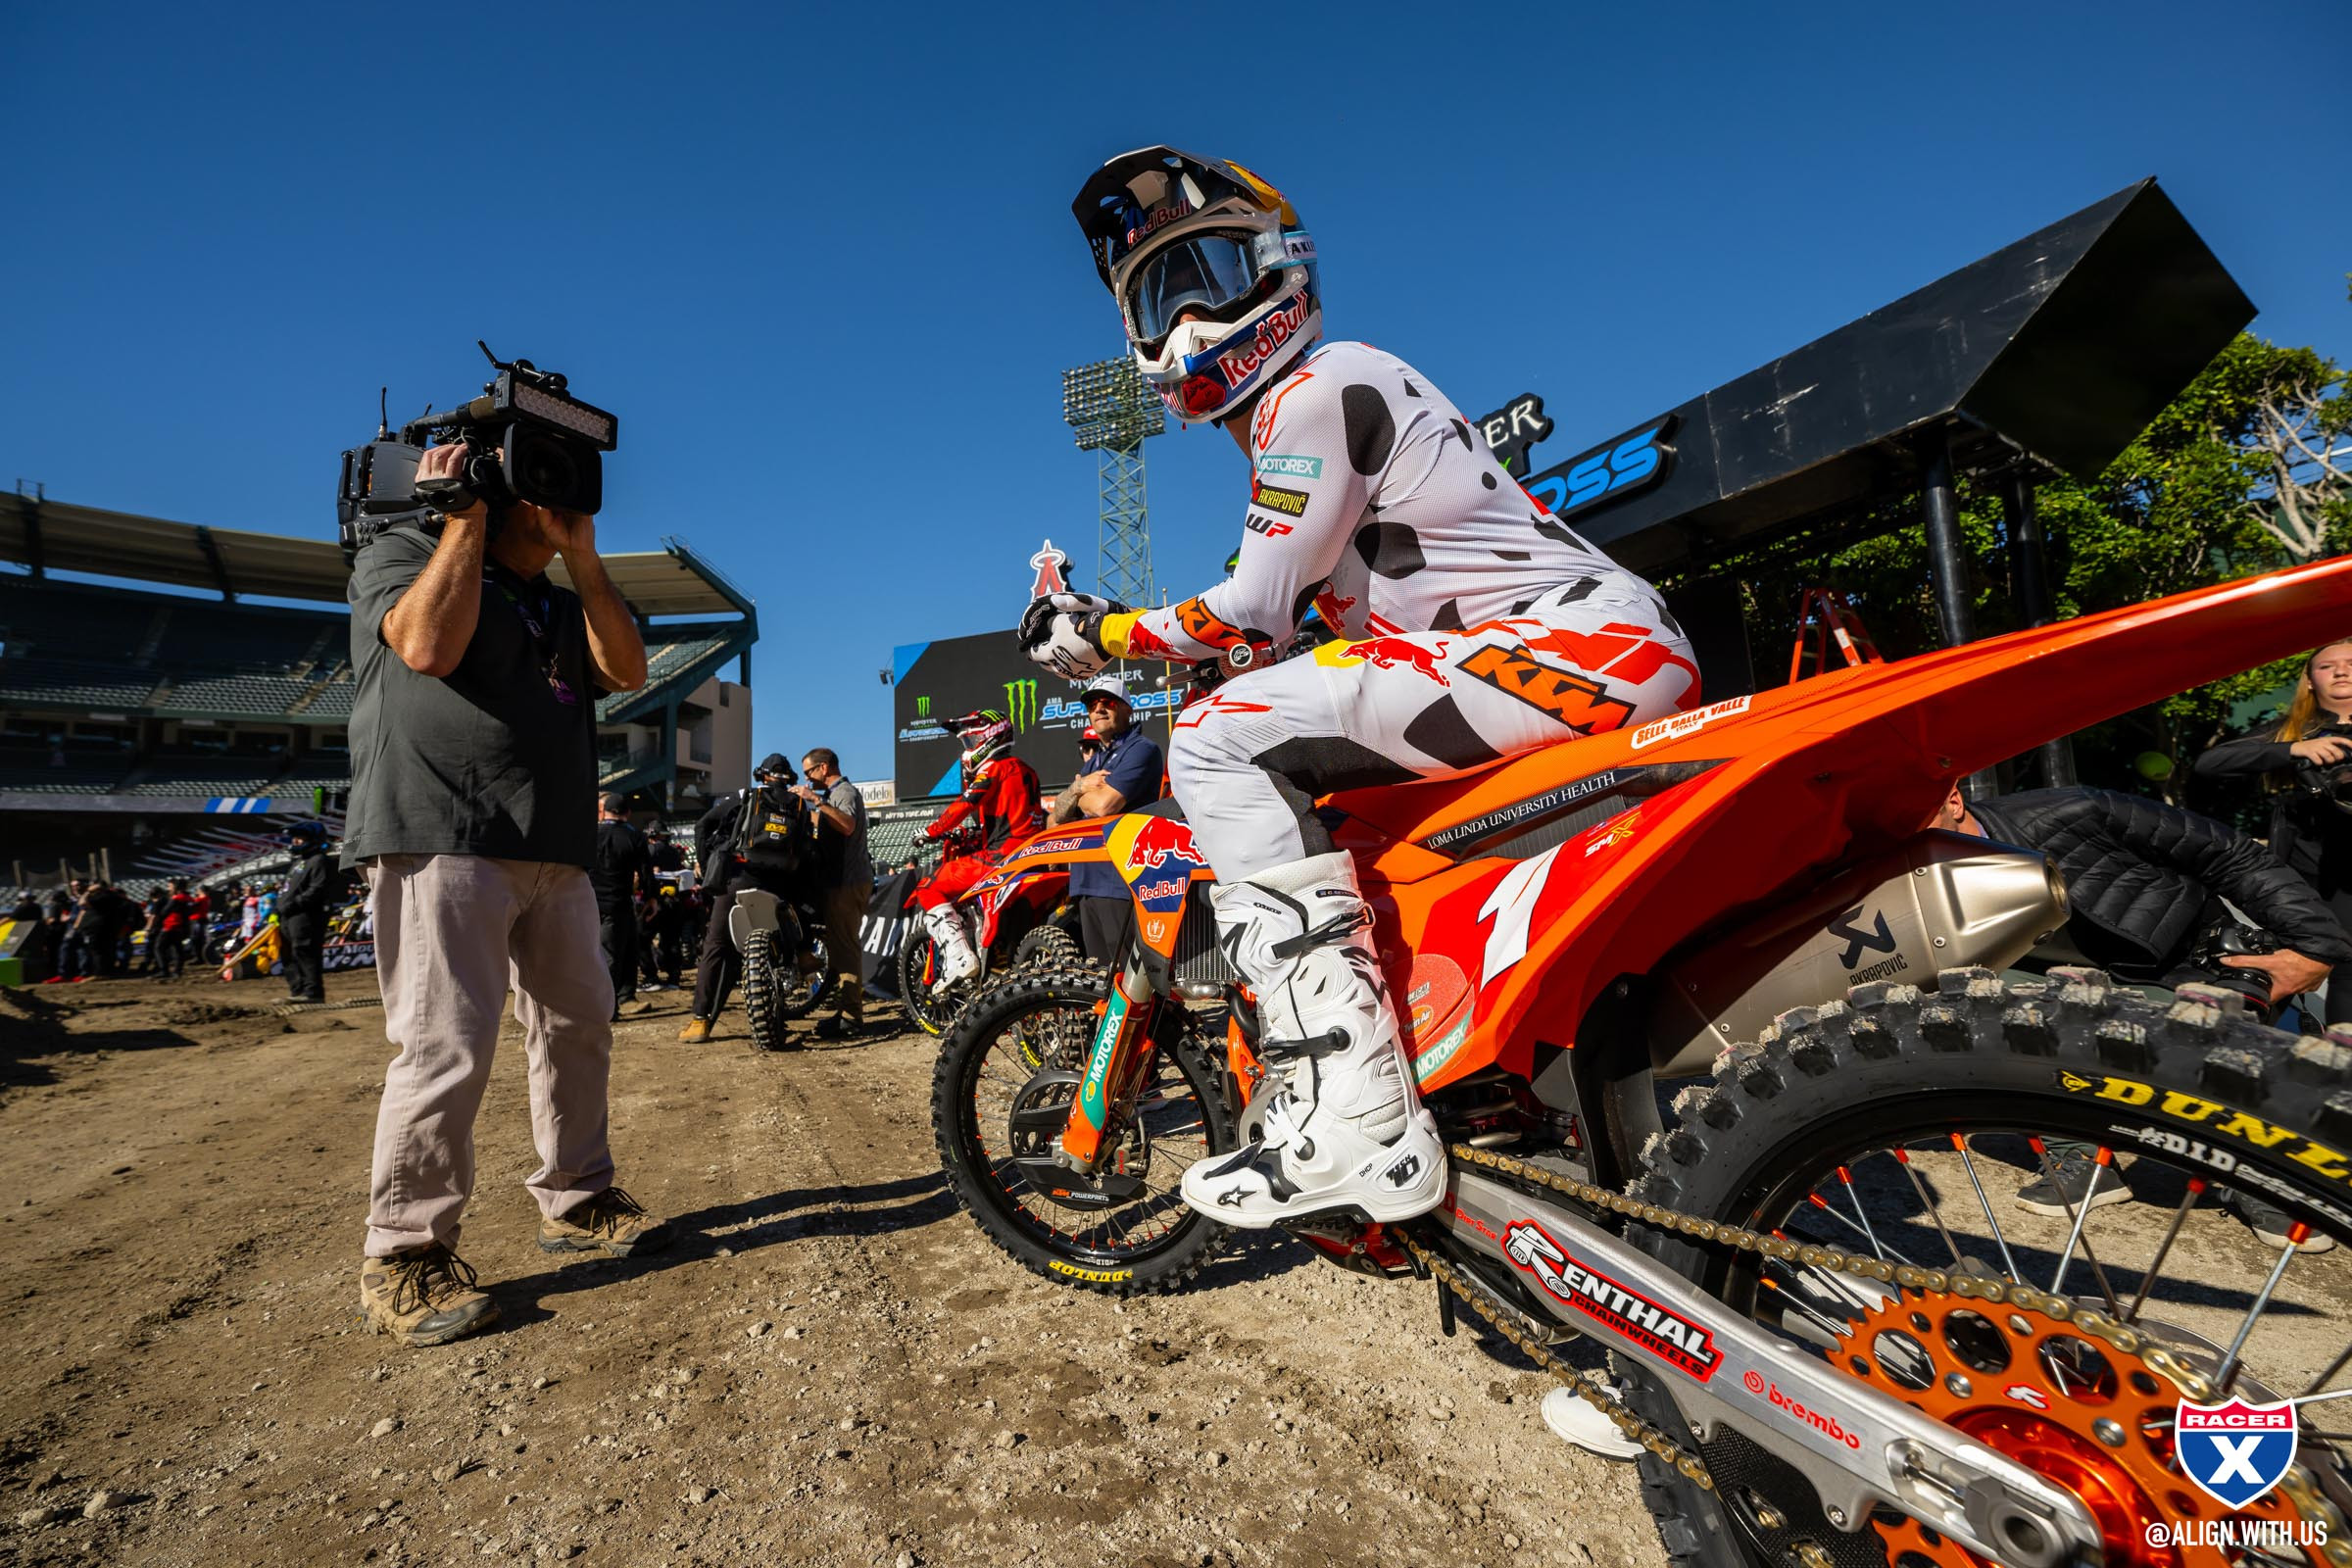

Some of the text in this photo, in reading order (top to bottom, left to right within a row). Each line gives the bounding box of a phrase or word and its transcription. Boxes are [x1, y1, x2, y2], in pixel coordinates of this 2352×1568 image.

[1216, 289, 1309, 390] Red Bull
[1258, 458, 1315, 474] MOTOREX
[1454, 643, 1638, 737] KTM
[1637, 697, 1744, 745] SELLE DALLA VALLE
[1676, 720, 1698, 732] ITALY
[1427, 771, 1615, 850] LOMA LINDA UNIVERSITY HEALTH
[1019, 837, 1083, 858] Red Bull
[1139, 877, 1185, 901] Red Bull
[1476, 841, 1567, 994] 1
[1090, 1009, 1123, 1082] MOTOREX
[1416, 1021, 1465, 1079] MOTOREX
[2094, 1076, 2352, 1188] DUNL
[1071, 1192, 1109, 1201] POWERPARTS
[1049, 1261, 1124, 1282] DUNLOP
[1573, 1296, 1706, 1377] CHAINWHEELS
[1768, 1384, 1860, 1449] brembo
